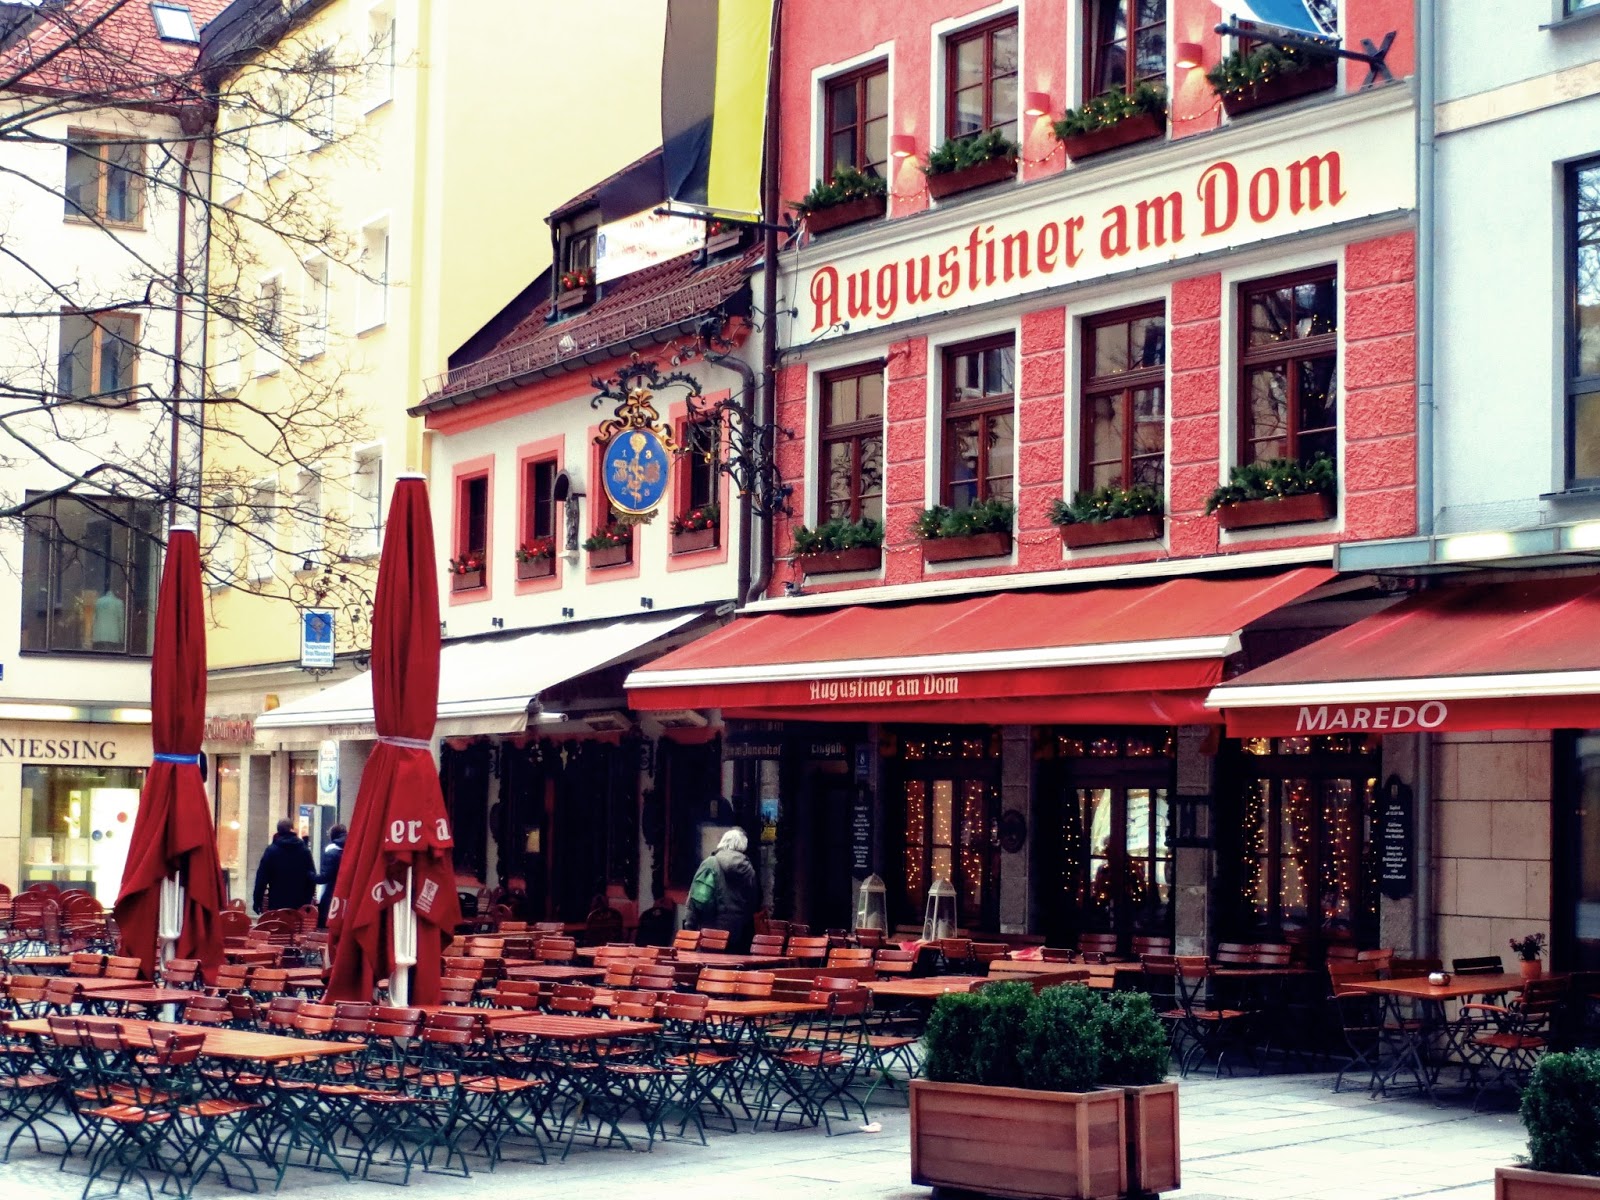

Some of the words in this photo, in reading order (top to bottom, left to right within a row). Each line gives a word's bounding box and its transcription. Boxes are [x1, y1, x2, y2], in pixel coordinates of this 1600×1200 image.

[810, 216, 1085, 333] Augustiner
[1101, 190, 1185, 261] am
[1197, 150, 1347, 237] Dom
[810, 677, 893, 700] Augustiner
[897, 678, 919, 696] am
[923, 673, 959, 695] Dom
[1295, 701, 1448, 731] MAREDO
[0, 738, 117, 760] NIESSING
[385, 819, 422, 843] er
